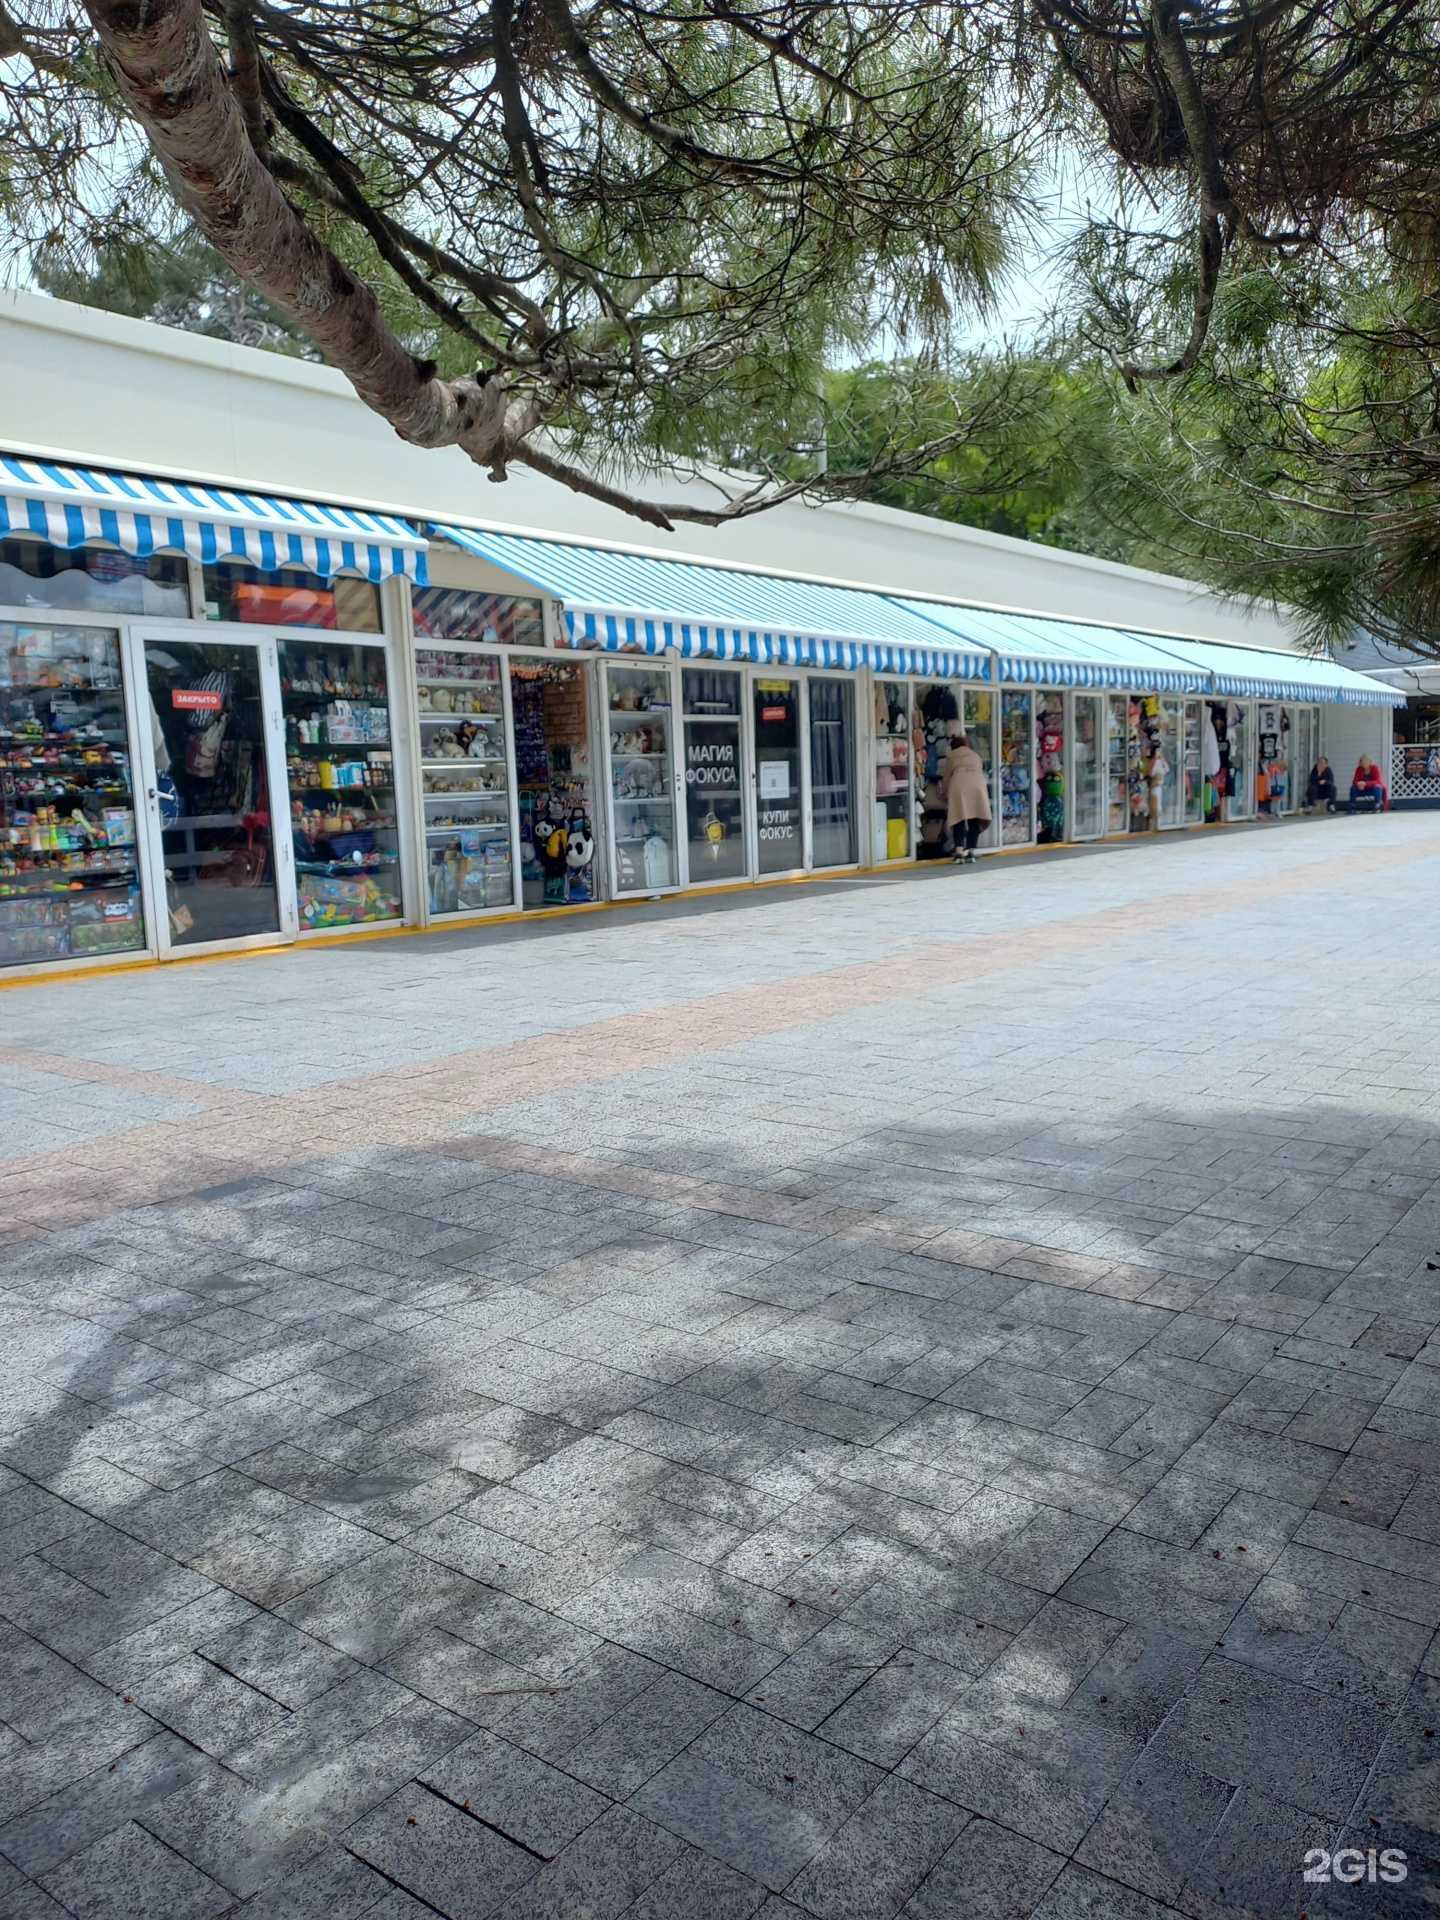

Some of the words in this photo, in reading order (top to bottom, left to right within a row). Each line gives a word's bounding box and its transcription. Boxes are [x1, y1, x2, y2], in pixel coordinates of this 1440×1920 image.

[688, 745, 733, 761] МАГИЯ
[685, 766, 736, 783] ФОКУСА
[762, 810, 789, 824] КУПИ
[759, 825, 793, 840] ФОКУС
